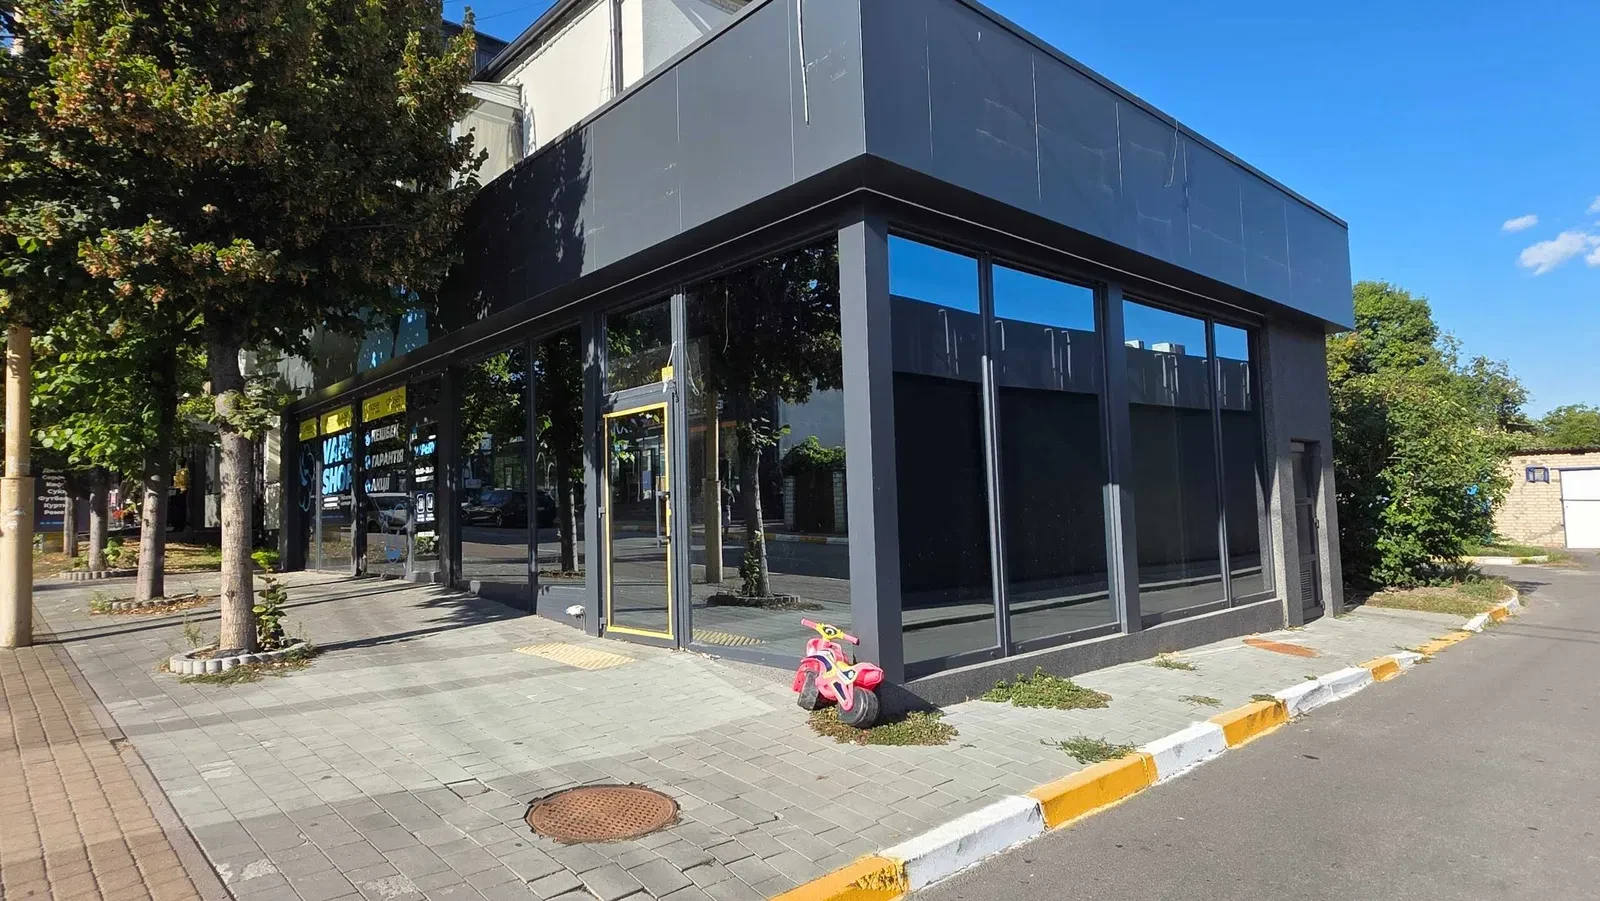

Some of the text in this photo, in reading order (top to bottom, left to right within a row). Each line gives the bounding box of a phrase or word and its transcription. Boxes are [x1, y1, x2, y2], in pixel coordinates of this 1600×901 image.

[371, 423, 399, 443] КЕШБЕК
[323, 432, 353, 465] VAPE
[371, 449, 404, 468] ГАРАНТІЯ
[321, 463, 352, 495] SHOP
